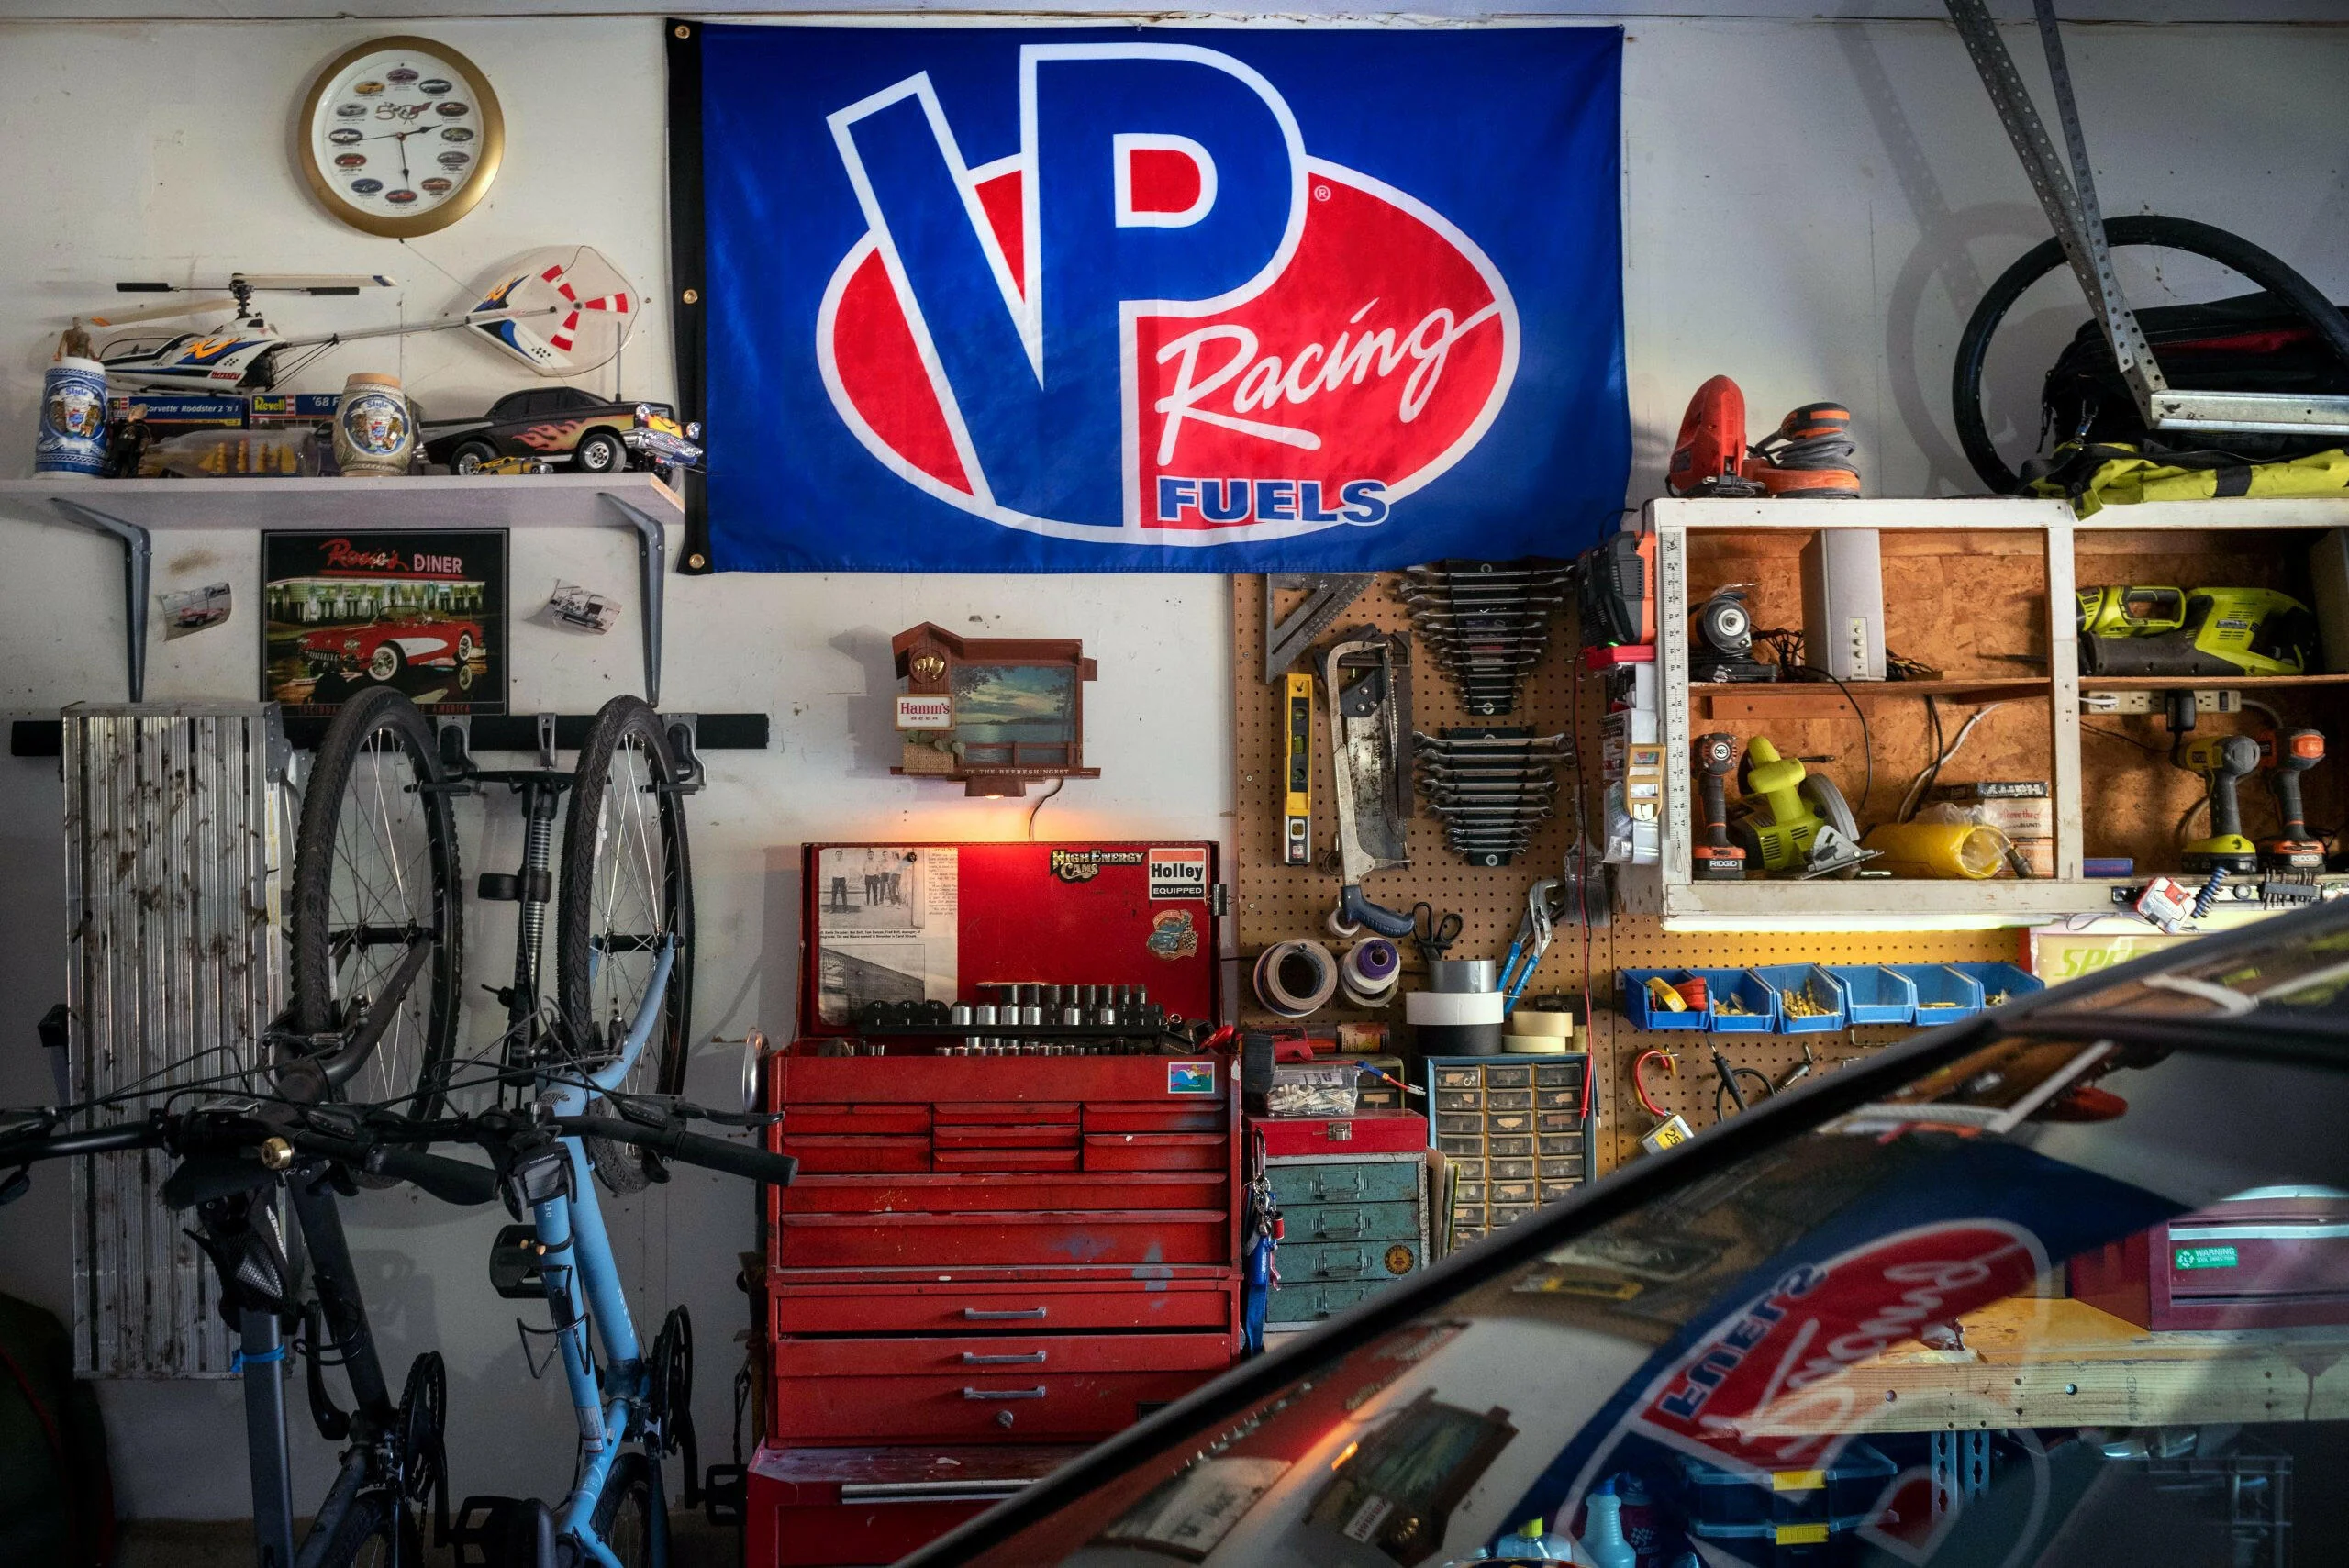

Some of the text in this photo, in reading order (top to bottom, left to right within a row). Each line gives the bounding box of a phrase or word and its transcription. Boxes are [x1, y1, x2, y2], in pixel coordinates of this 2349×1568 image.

[826, 44, 1307, 528] VP
[1155, 296, 1500, 466] Racing
[254, 396, 286, 411] Revell
[1156, 475, 1390, 527] FUELS
[414, 553, 462, 573] DINER
[900, 702, 950, 715] Hamm's
[1052, 850, 1145, 869] HIGH ENERGY
[1061, 862, 1099, 880] CAMS
[1151, 863, 1204, 882] Holley
[1664, 1129, 1682, 1146] 25
[2195, 1248, 2235, 1257] WARNING
